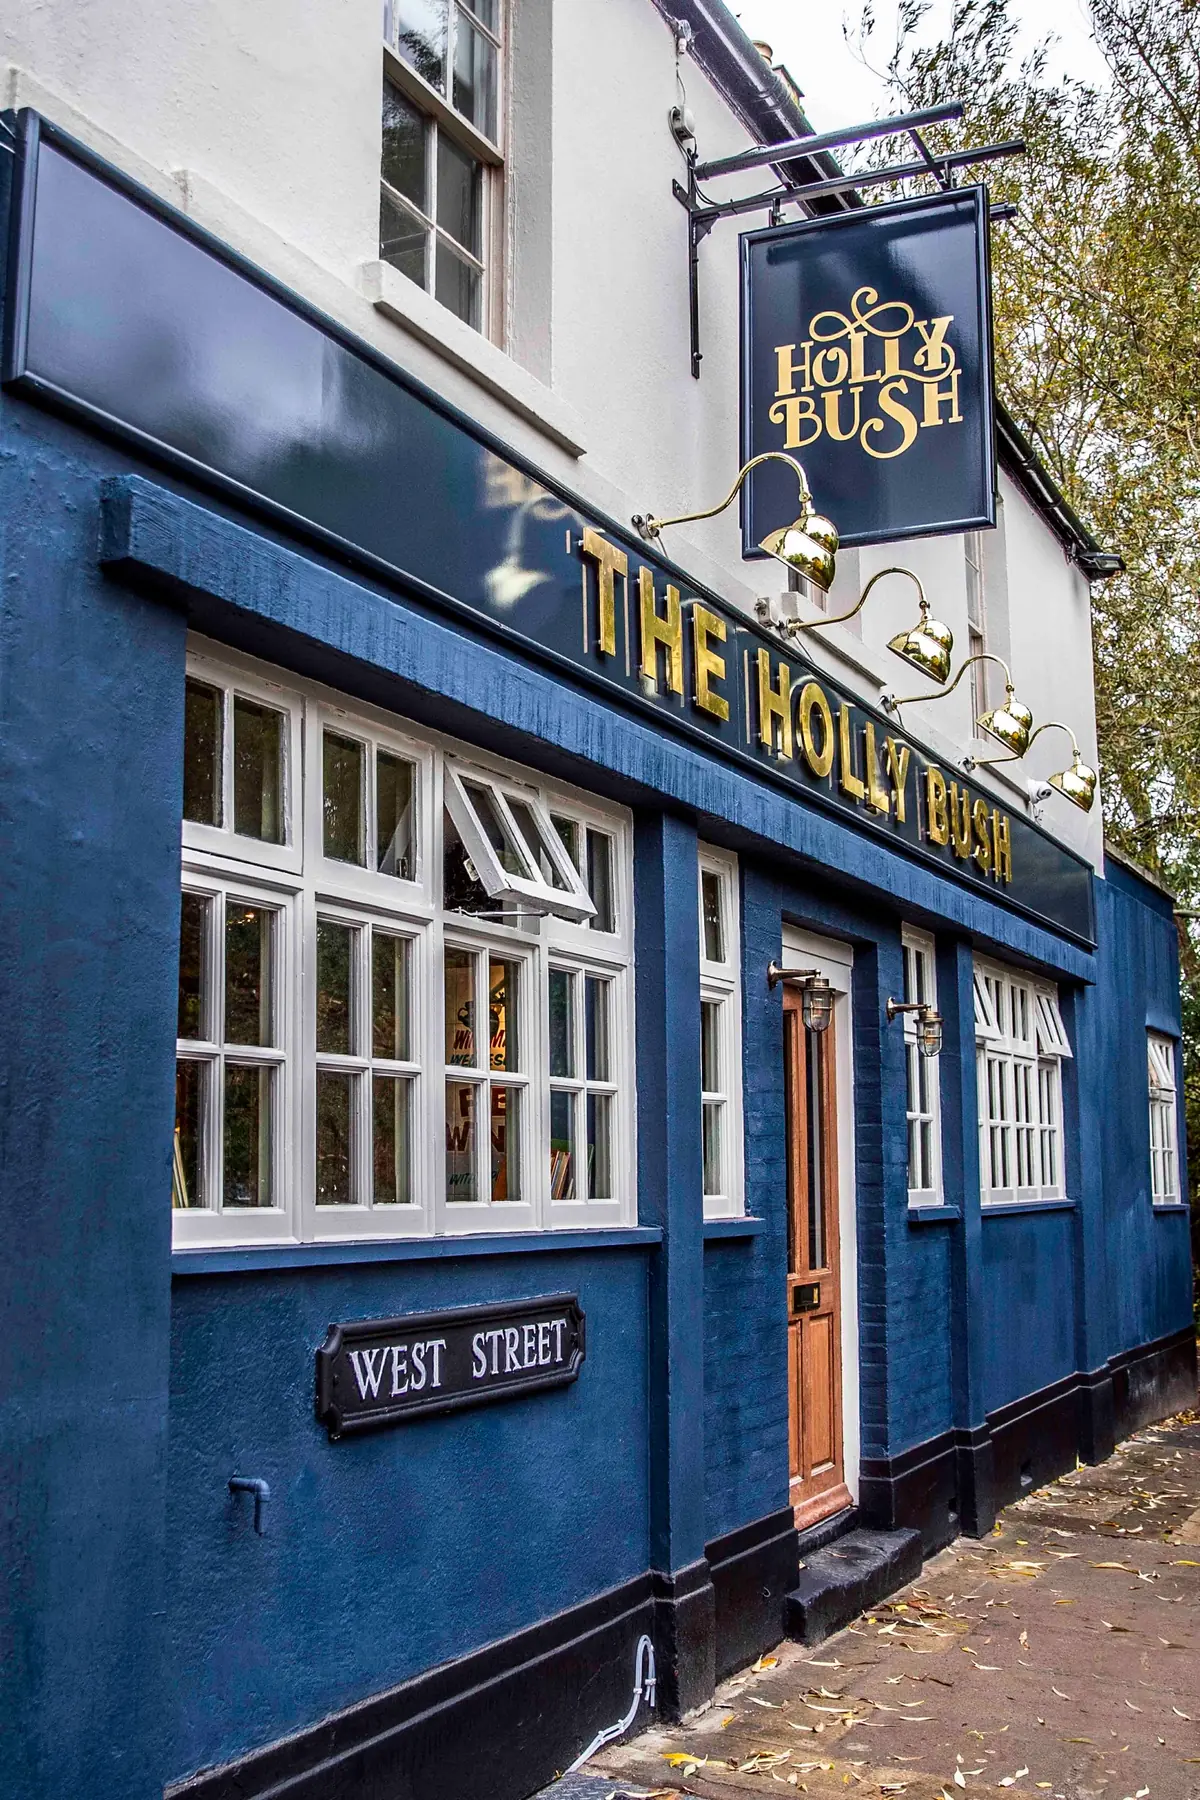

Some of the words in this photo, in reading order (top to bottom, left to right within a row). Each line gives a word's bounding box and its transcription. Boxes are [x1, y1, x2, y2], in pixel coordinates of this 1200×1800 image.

[774, 286, 956, 397] HOLLY
[768, 368, 964, 459] BUSH
[582, 526, 730, 723] THE
[757, 646, 910, 824] HOLLY
[926, 765, 1013, 884] BUSH
[350, 1339, 447, 1400] WEST
[472, 1318, 567, 1379] STREET
